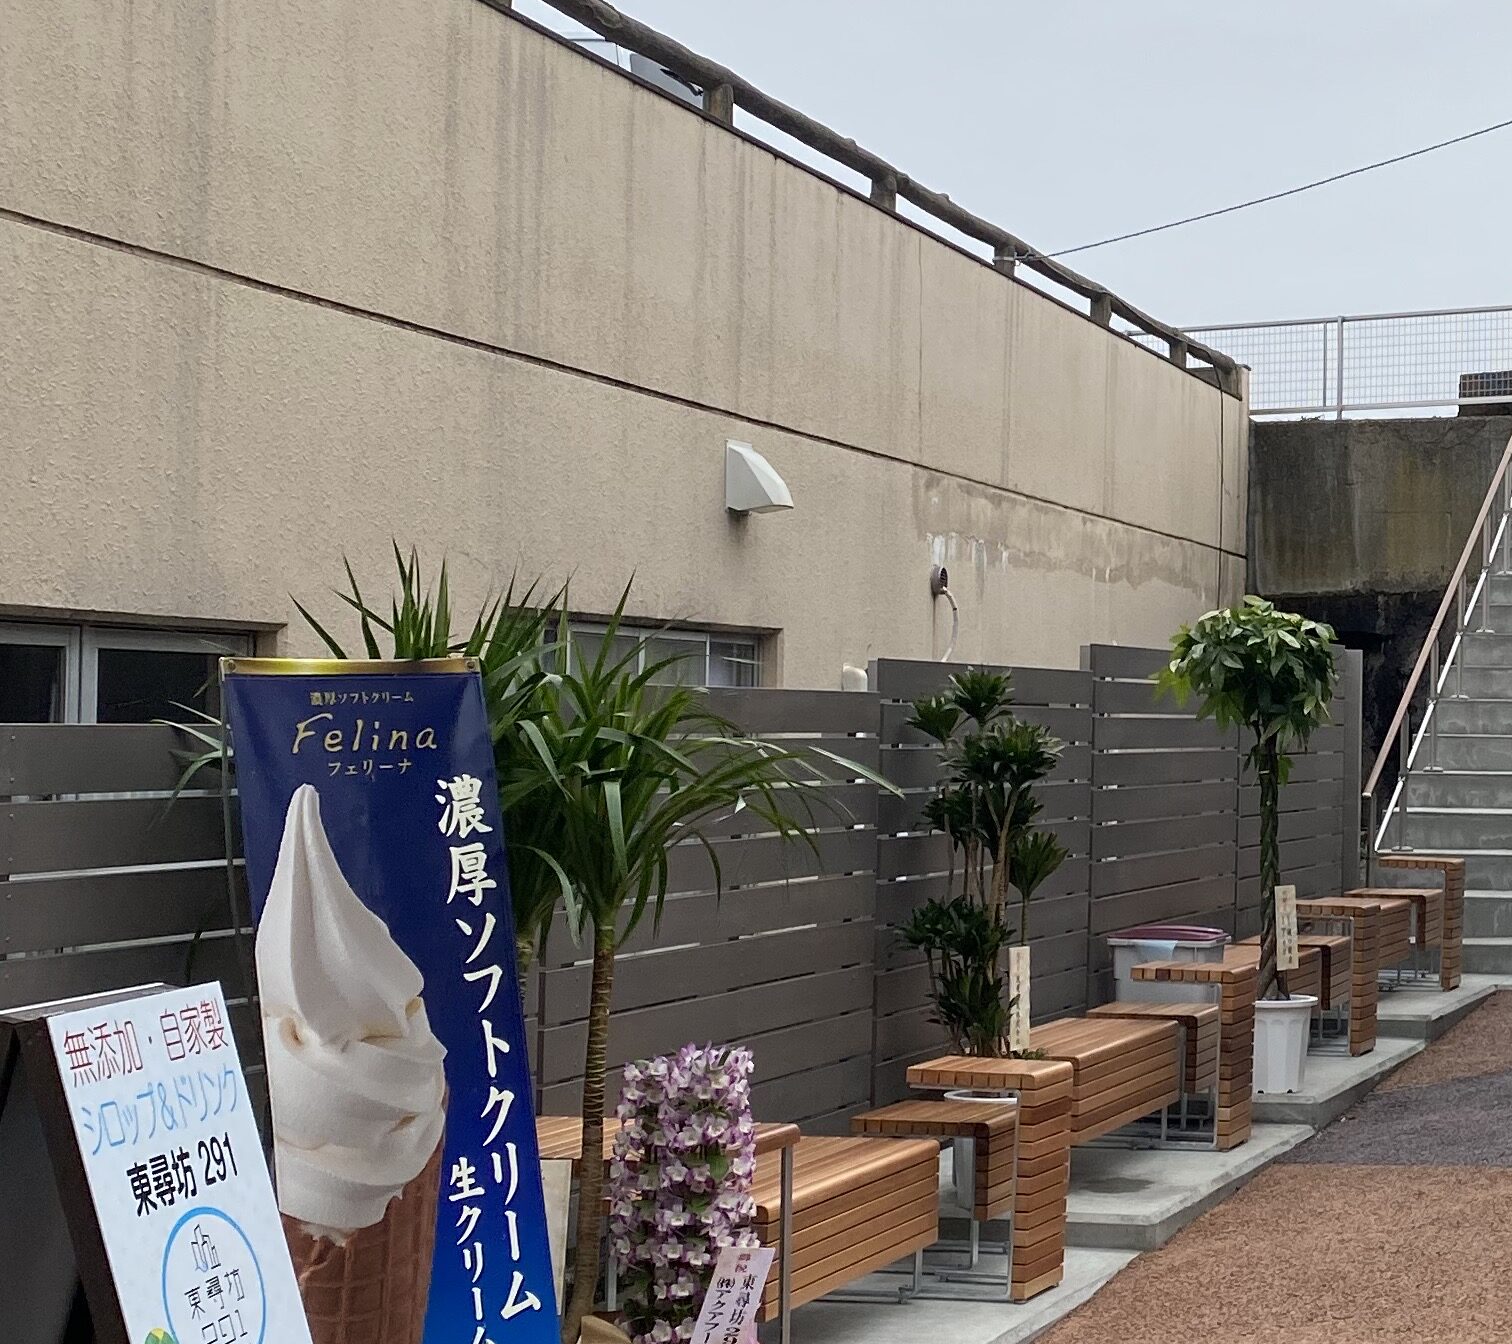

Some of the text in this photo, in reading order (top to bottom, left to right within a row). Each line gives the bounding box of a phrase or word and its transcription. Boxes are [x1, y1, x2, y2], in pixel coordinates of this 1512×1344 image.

[291, 712, 438, 754] Felina
[328, 758, 413, 777] フェリーナ
[63, 1000, 229, 1088] 無添加・自家製
[434, 773, 541, 1320] 濃厚ソフトクリーム
[126, 1132, 238, 1218] 東尋坊 291
[183, 1267, 246, 1320] 東尋坊
